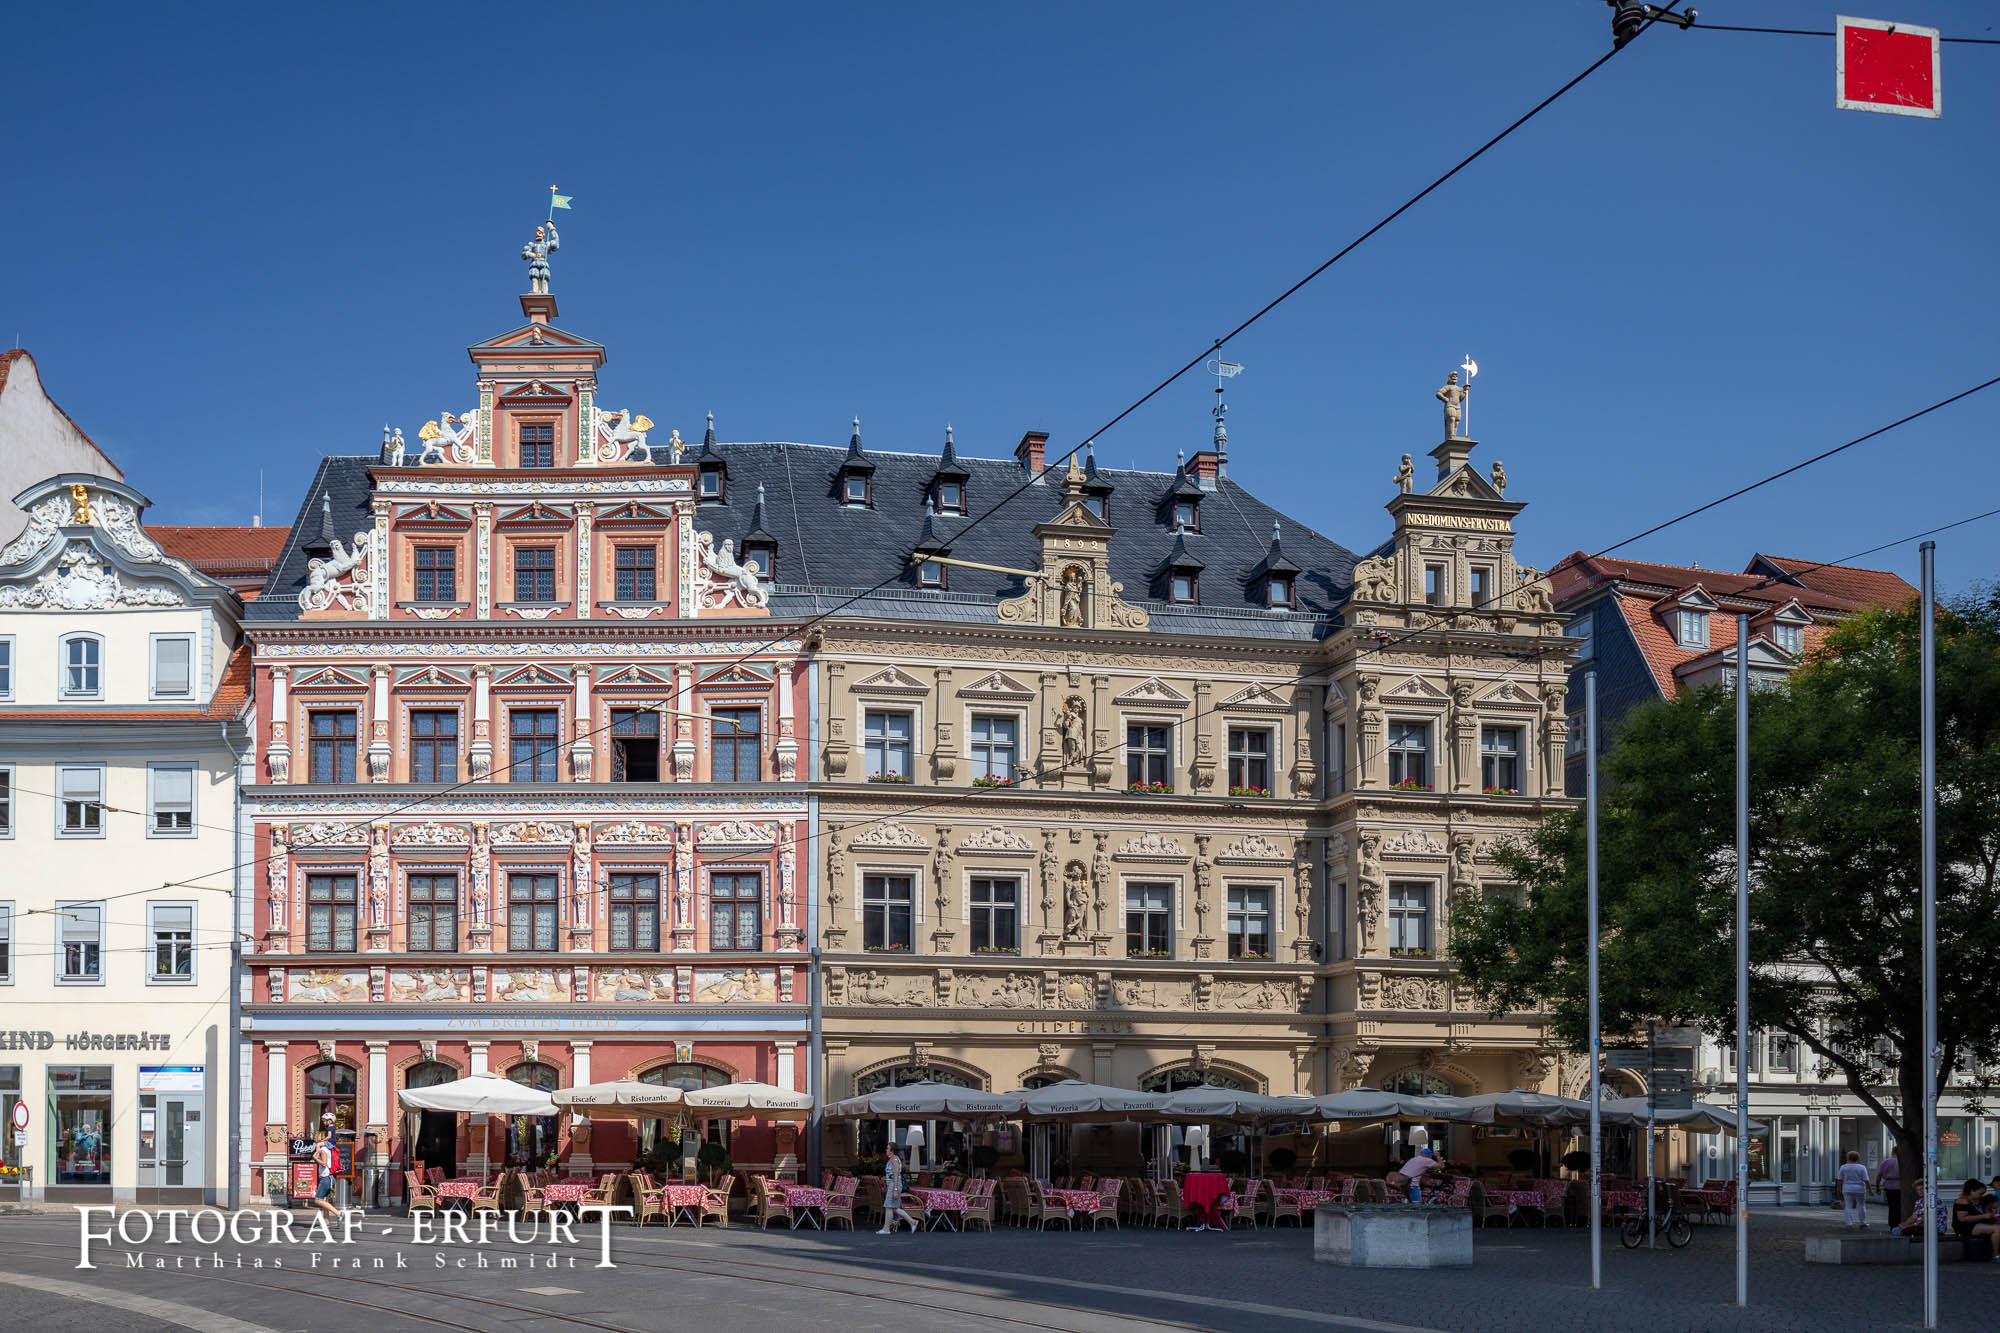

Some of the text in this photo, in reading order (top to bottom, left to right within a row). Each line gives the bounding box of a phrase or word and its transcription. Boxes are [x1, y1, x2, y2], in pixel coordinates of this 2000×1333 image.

[1053, 538, 1098, 550] 1892
[492, 1015, 561, 1028] BREITEN
[572, 1015, 619, 1028] HERD
[1016, 1020, 1136, 1034] GILDEHAUS
[66, 1031, 171, 1050] HÖRGERÄTE
[631, 1094, 668, 1103] Ristorante
[702, 1098, 731, 1106] Pizzeria
[766, 1099, 799, 1108] Pavarotti
[966, 1102, 1004, 1111] Ristorante
[1050, 1104, 1079, 1112] Pizzeria
[1123, 1101, 1154, 1109] Pavarotti
